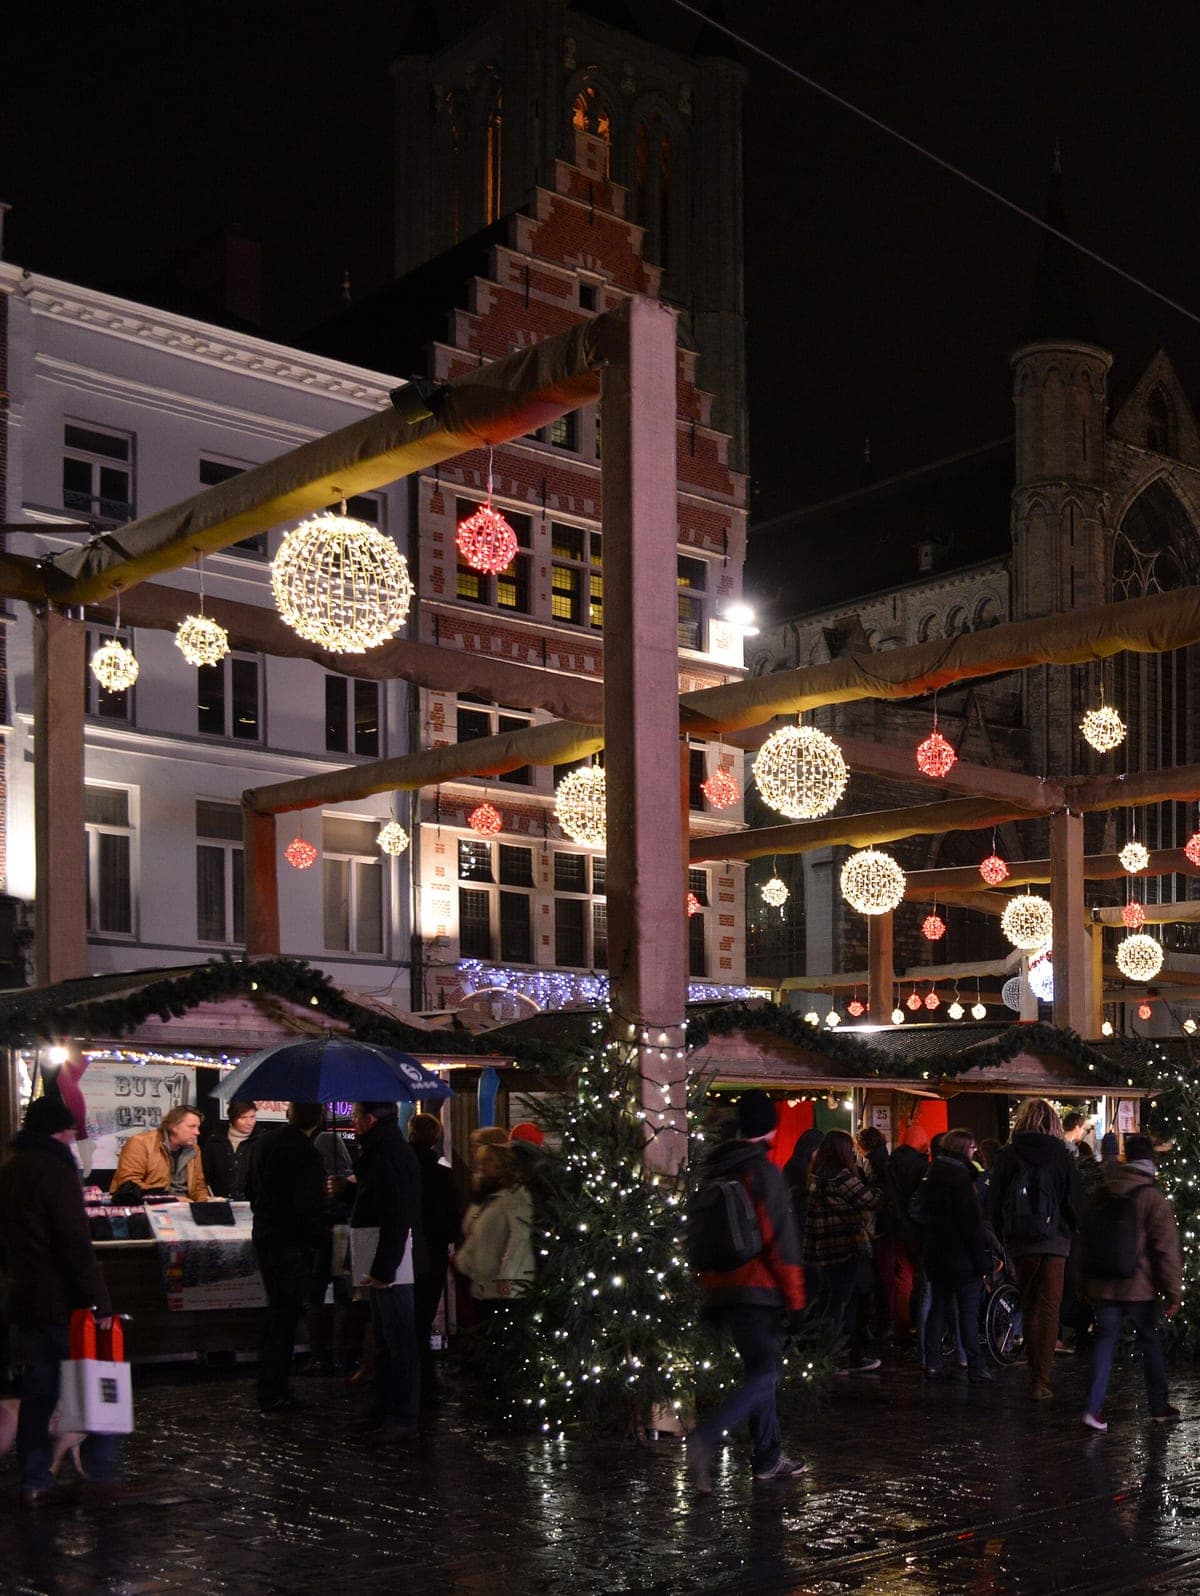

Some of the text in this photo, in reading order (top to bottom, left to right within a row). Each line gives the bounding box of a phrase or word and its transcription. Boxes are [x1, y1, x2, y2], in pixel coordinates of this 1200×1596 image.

[114, 1072, 190, 1111] BUY 1
[115, 1105, 162, 1127] GET
[876, 1109, 888, 1120] 25
